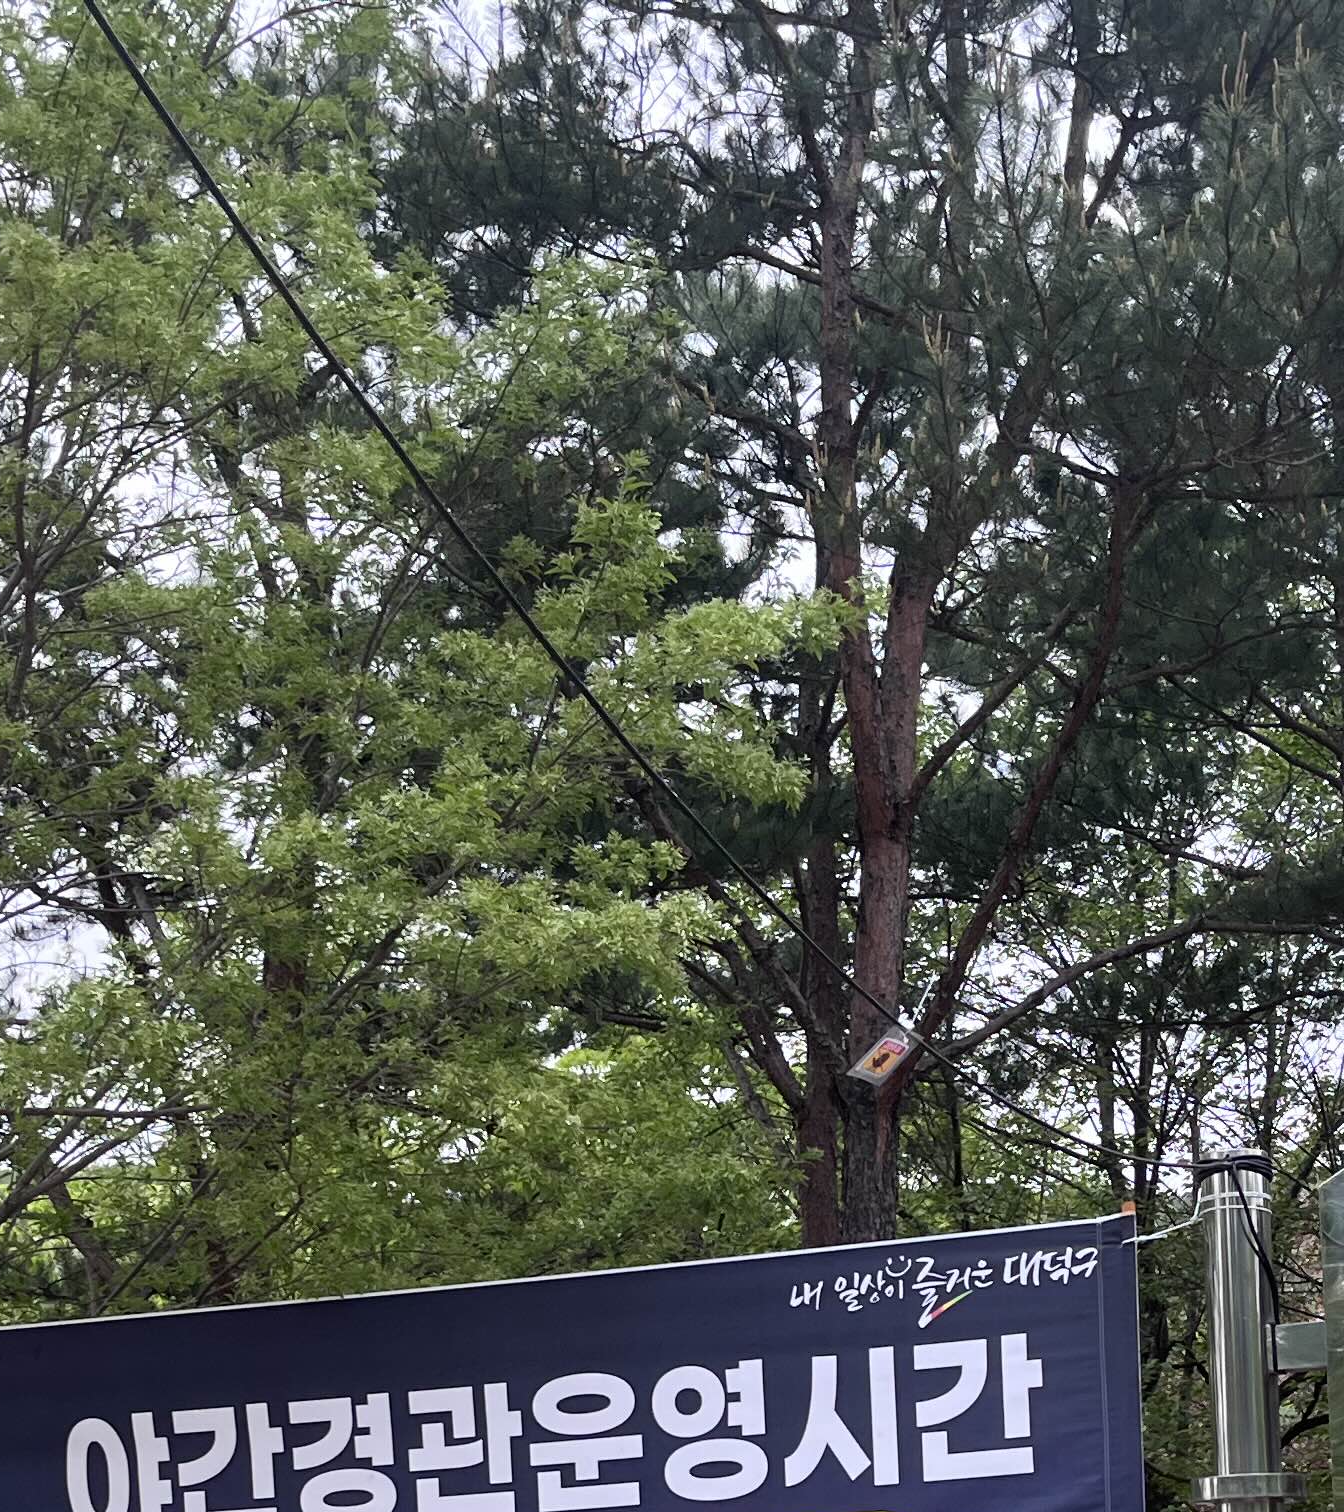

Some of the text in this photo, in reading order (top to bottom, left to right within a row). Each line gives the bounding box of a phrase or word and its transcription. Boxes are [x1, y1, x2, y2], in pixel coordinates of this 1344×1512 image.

[790, 1247, 1098, 1329] 내 일상이 즐거운 대덕구
